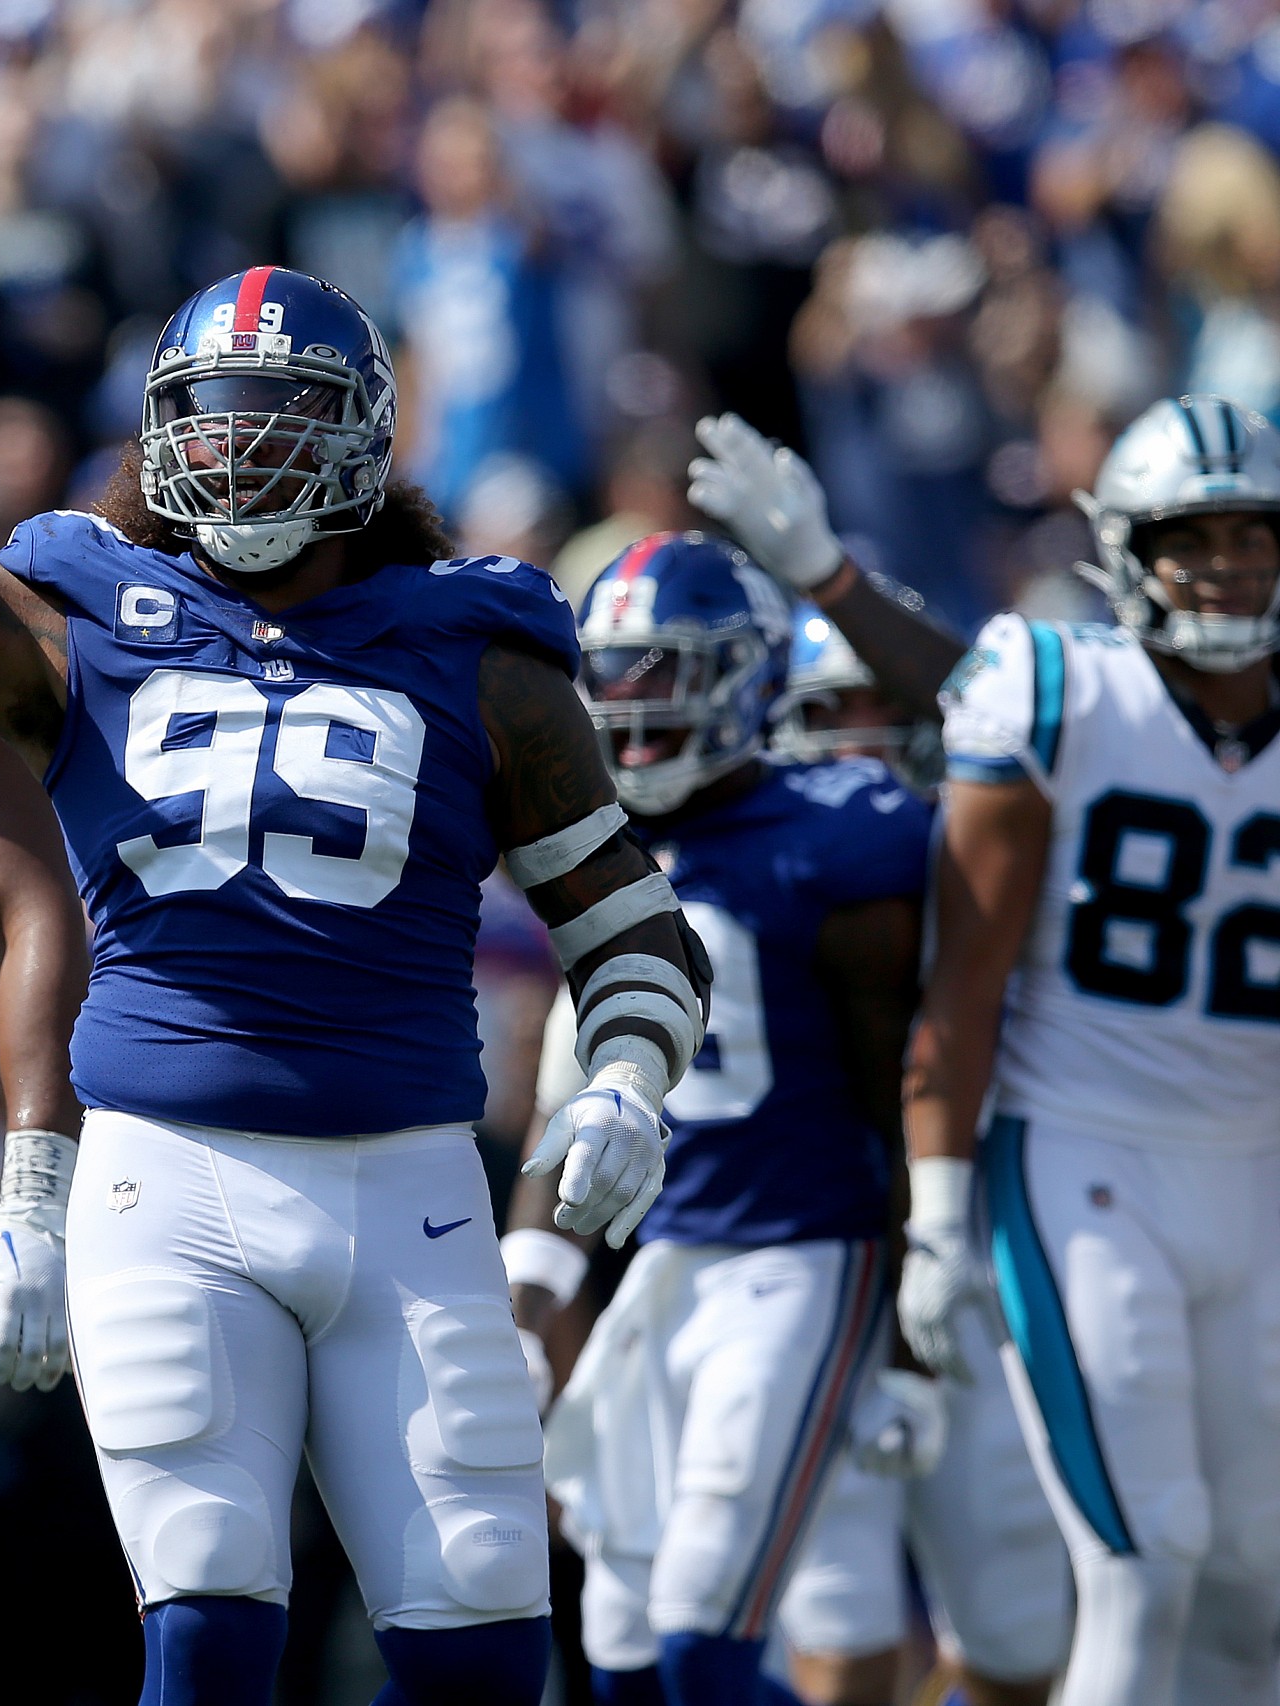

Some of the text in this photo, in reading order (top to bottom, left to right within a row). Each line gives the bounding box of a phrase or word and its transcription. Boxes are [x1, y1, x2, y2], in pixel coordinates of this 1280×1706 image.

[206, 302, 284, 334] 99
[120, 586, 175, 627] C
[116, 668, 426, 908] 99
[472, 1526, 523, 1544] schutt
